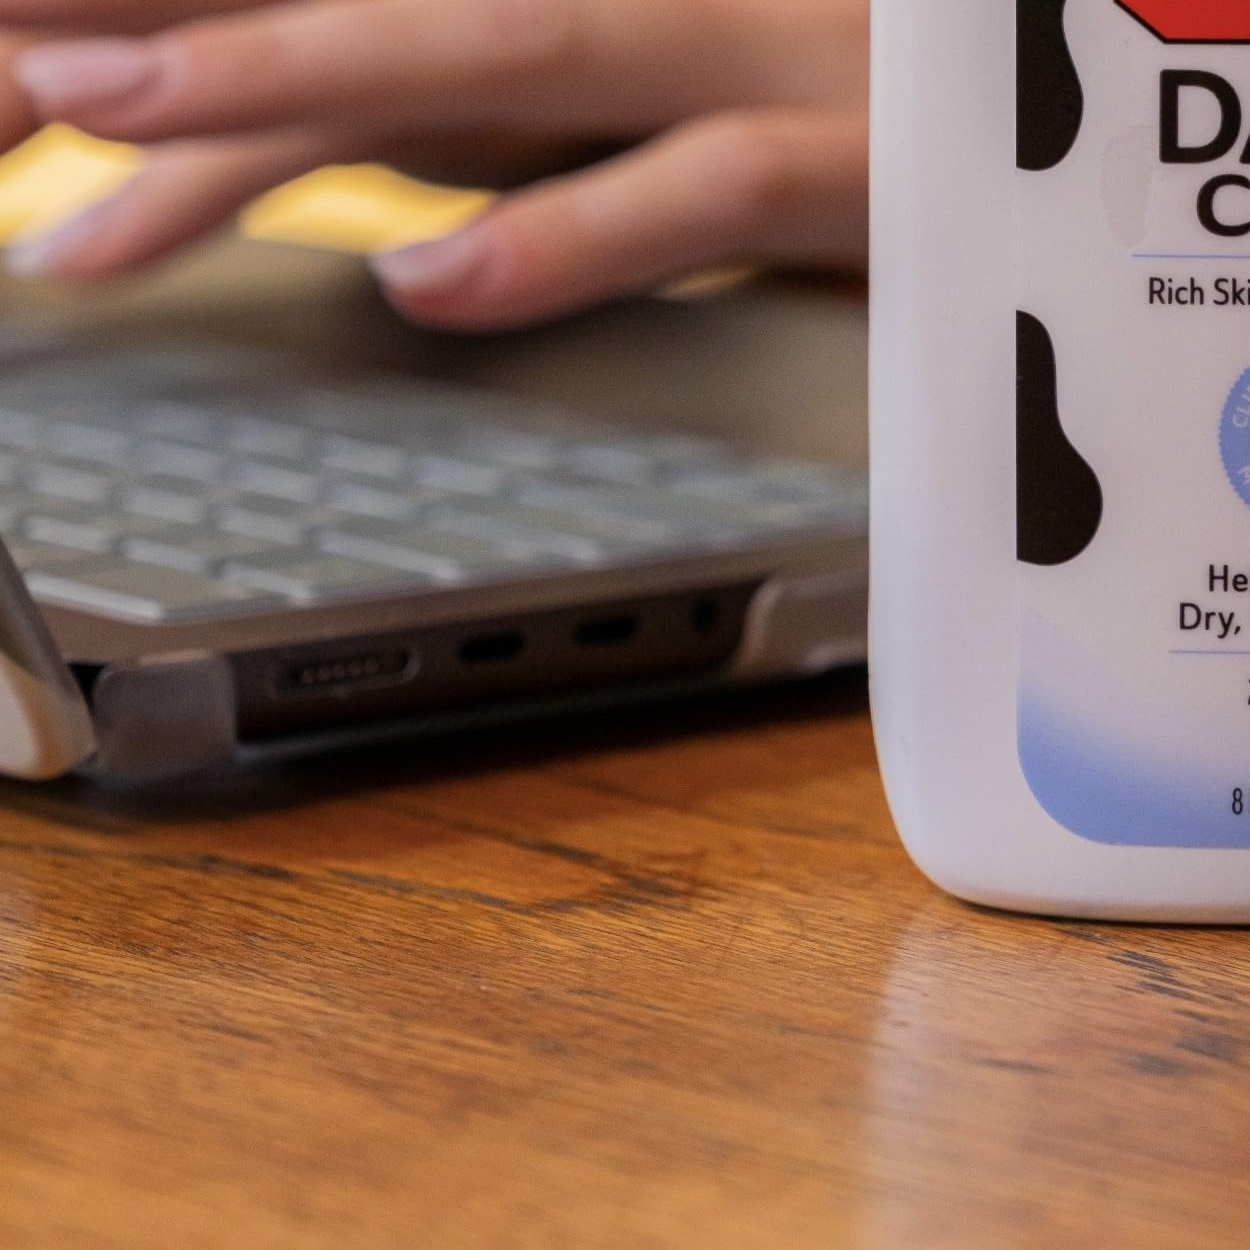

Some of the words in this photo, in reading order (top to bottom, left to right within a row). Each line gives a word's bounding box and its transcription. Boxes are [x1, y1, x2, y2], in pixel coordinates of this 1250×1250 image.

[1147, 276, 1204, 305] Rich
[1178, 603, 1242, 638] Dry,
[1230, 787, 1243, 816] 8
